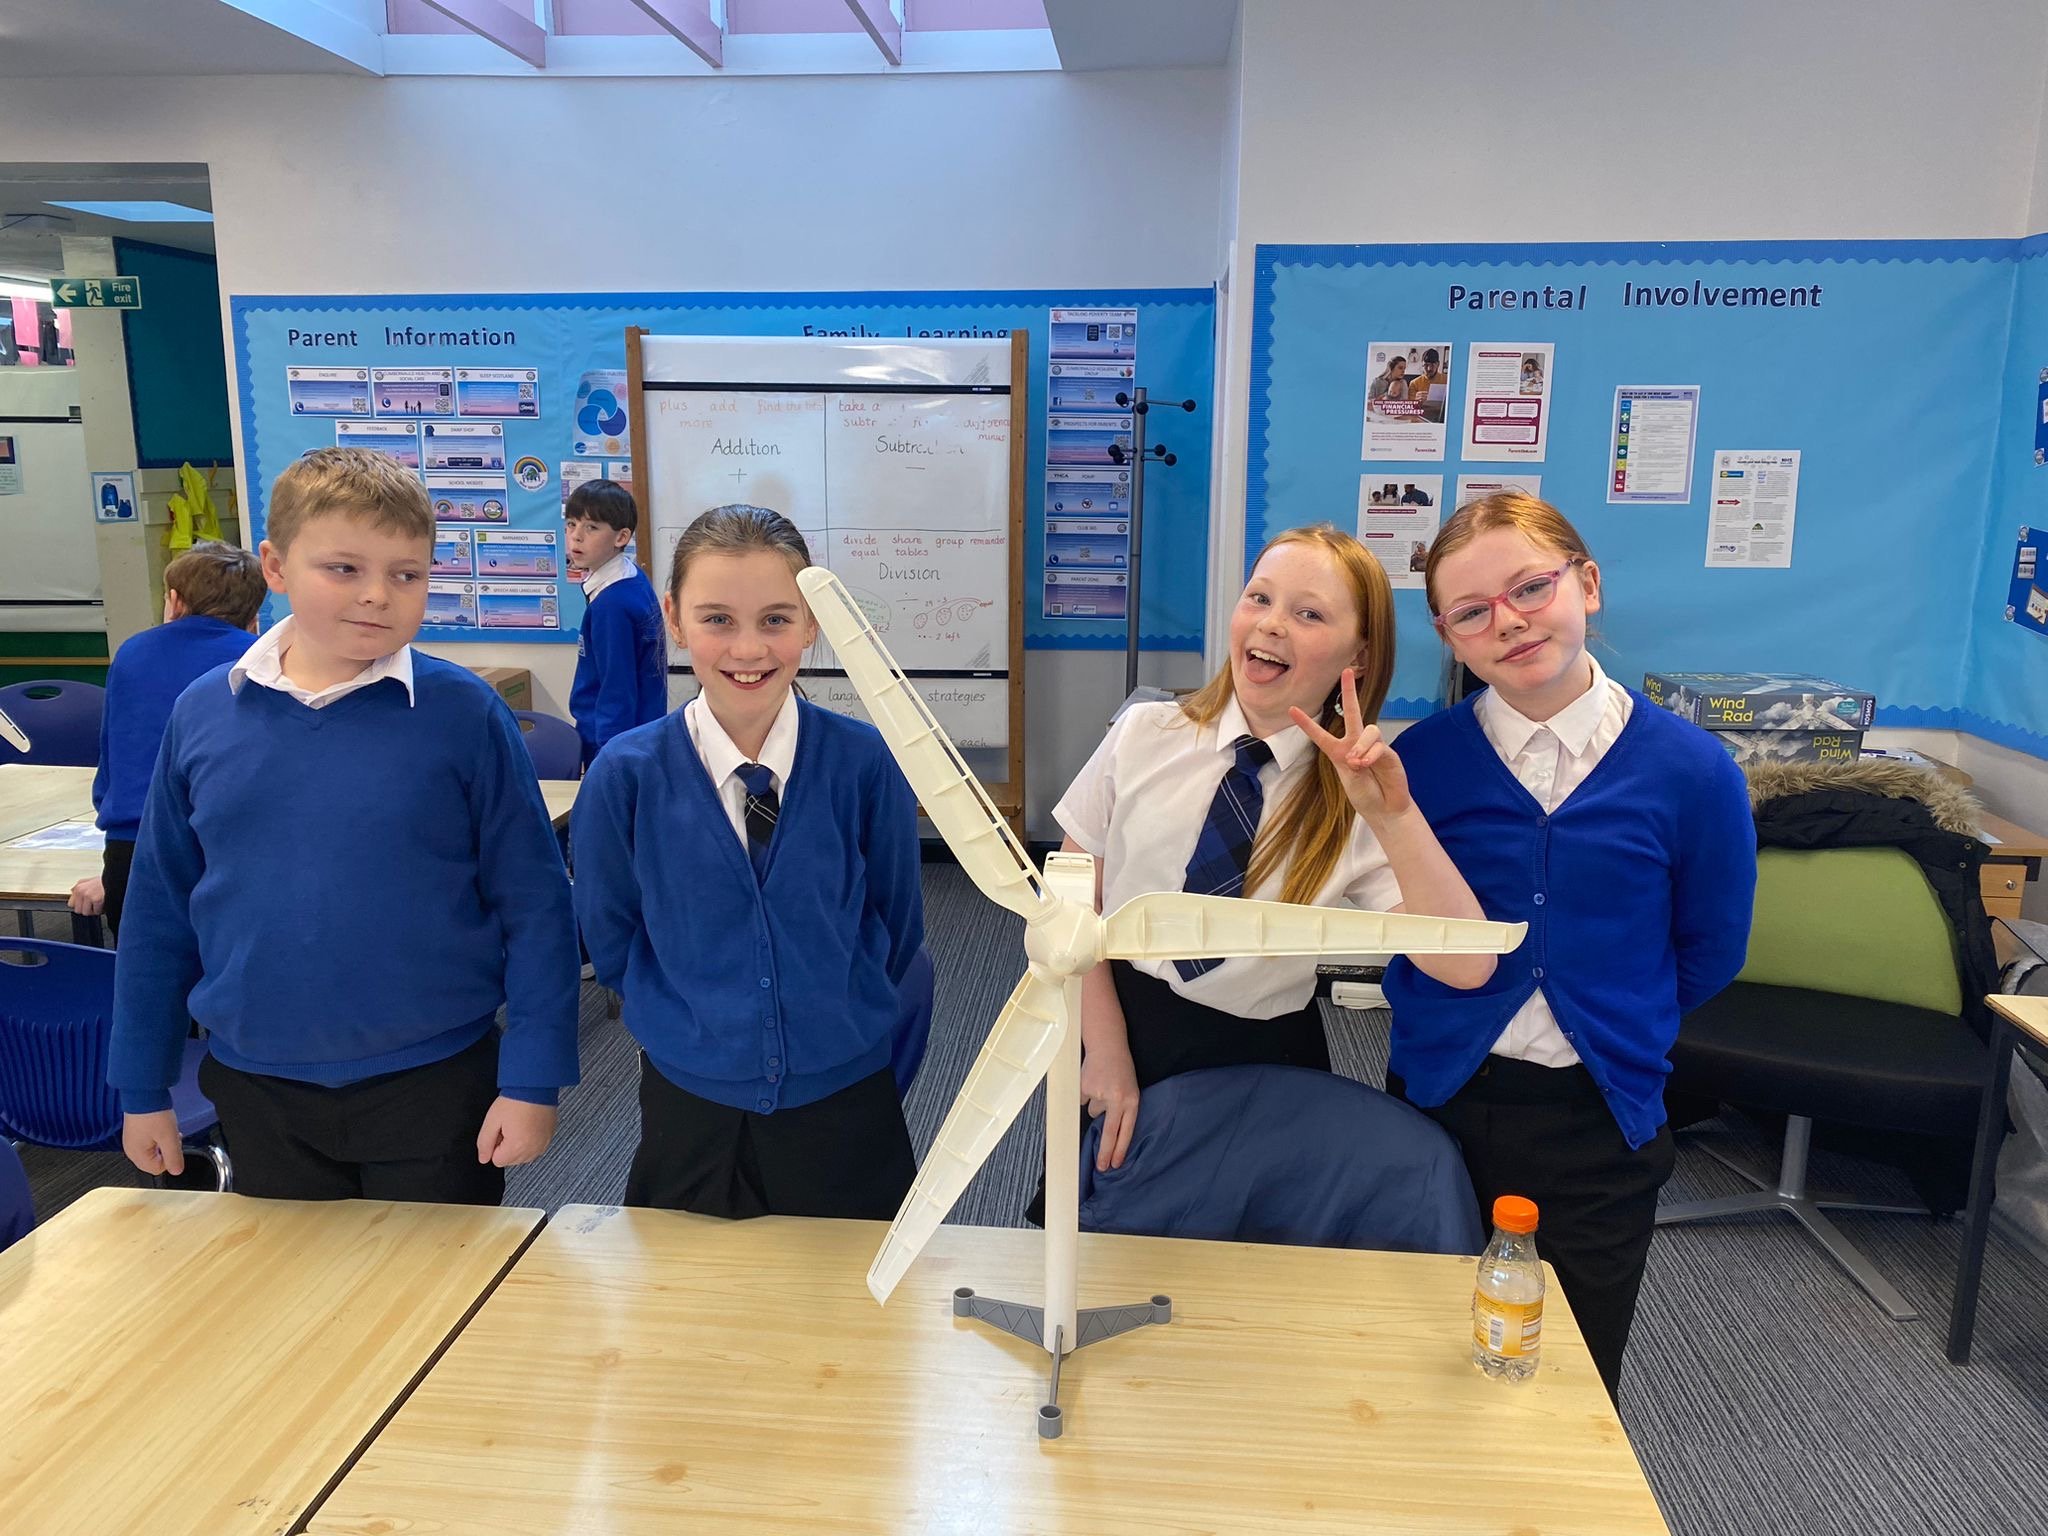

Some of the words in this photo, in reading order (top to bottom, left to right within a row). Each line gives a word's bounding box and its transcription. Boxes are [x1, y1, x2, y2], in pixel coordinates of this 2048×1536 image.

[112, 282, 131, 292] Fire
[113, 295, 132, 304] exit
[1449, 284, 1587, 311] Parental
[1623, 279, 1823, 307] Involvement
[288, 329, 358, 346] Parent
[385, 326, 515, 346] Information
[659, 400, 688, 415] plus
[710, 399, 738, 412] add
[838, 399, 866, 412] take
[710, 437, 782, 456] Addition
[843, 534, 877, 545] divide
[891, 535, 923, 545] share
[935, 537, 964, 549] group
[851, 548, 880, 558] equal
[895, 547, 929, 557] tables
[878, 562, 941, 581] Division
[1646, 677, 1662, 693] Wind
[828, 687, 862, 707] langu
[927, 687, 986, 707] strategies
[1650, 691, 1664, 706] Rad
[1709, 697, 1746, 709] Wind
[1722, 710, 1754, 722] Rad
[1864, 699, 1873, 726] KOSMOS
[960, 737, 987, 747] each
[1813, 736, 1841, 748] Rad
[1820, 748, 1852, 760] Wind
